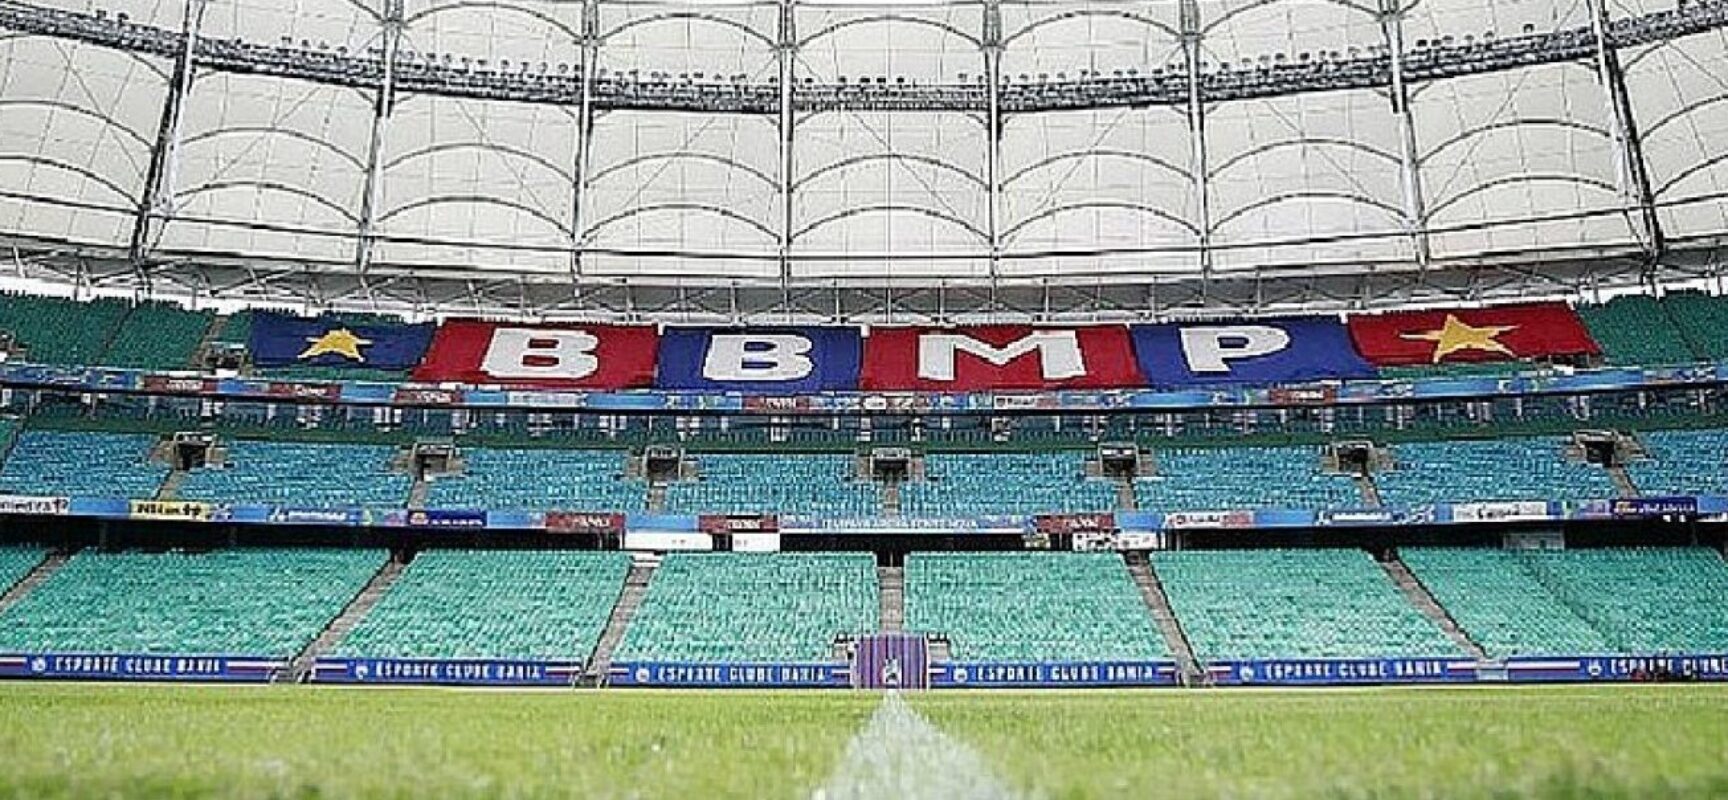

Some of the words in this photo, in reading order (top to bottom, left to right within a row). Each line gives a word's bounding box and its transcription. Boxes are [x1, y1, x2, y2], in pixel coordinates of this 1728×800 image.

[480, 327, 599, 380] B
[702, 333, 814, 382] B
[917, 329, 1087, 381] M
[1179, 325, 1291, 372] P
